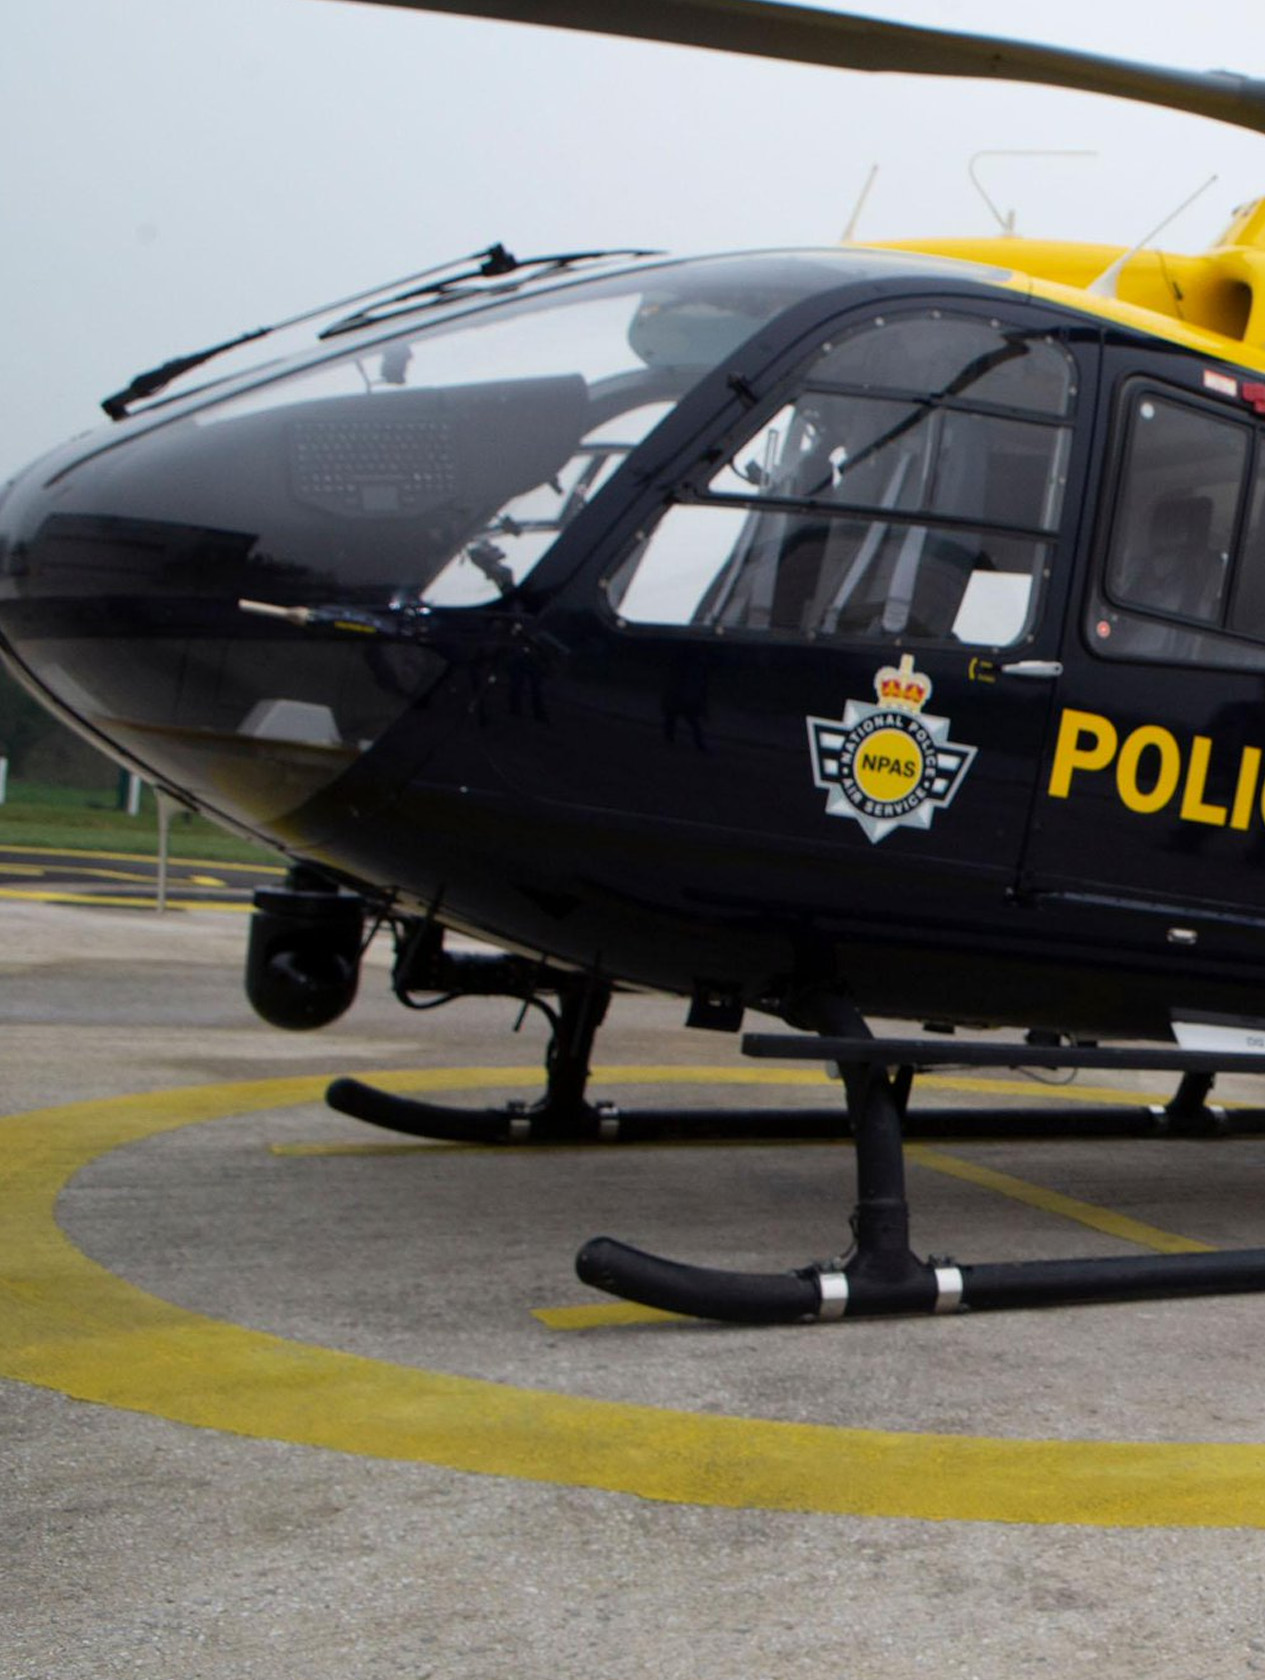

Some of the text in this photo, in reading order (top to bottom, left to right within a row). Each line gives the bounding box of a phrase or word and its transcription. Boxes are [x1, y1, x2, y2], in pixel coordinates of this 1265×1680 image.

[841, 714, 936, 777] NATIONAL POLICE
[862, 753, 916, 778] NPAS
[843, 778, 926, 816] AIR SERVICE
